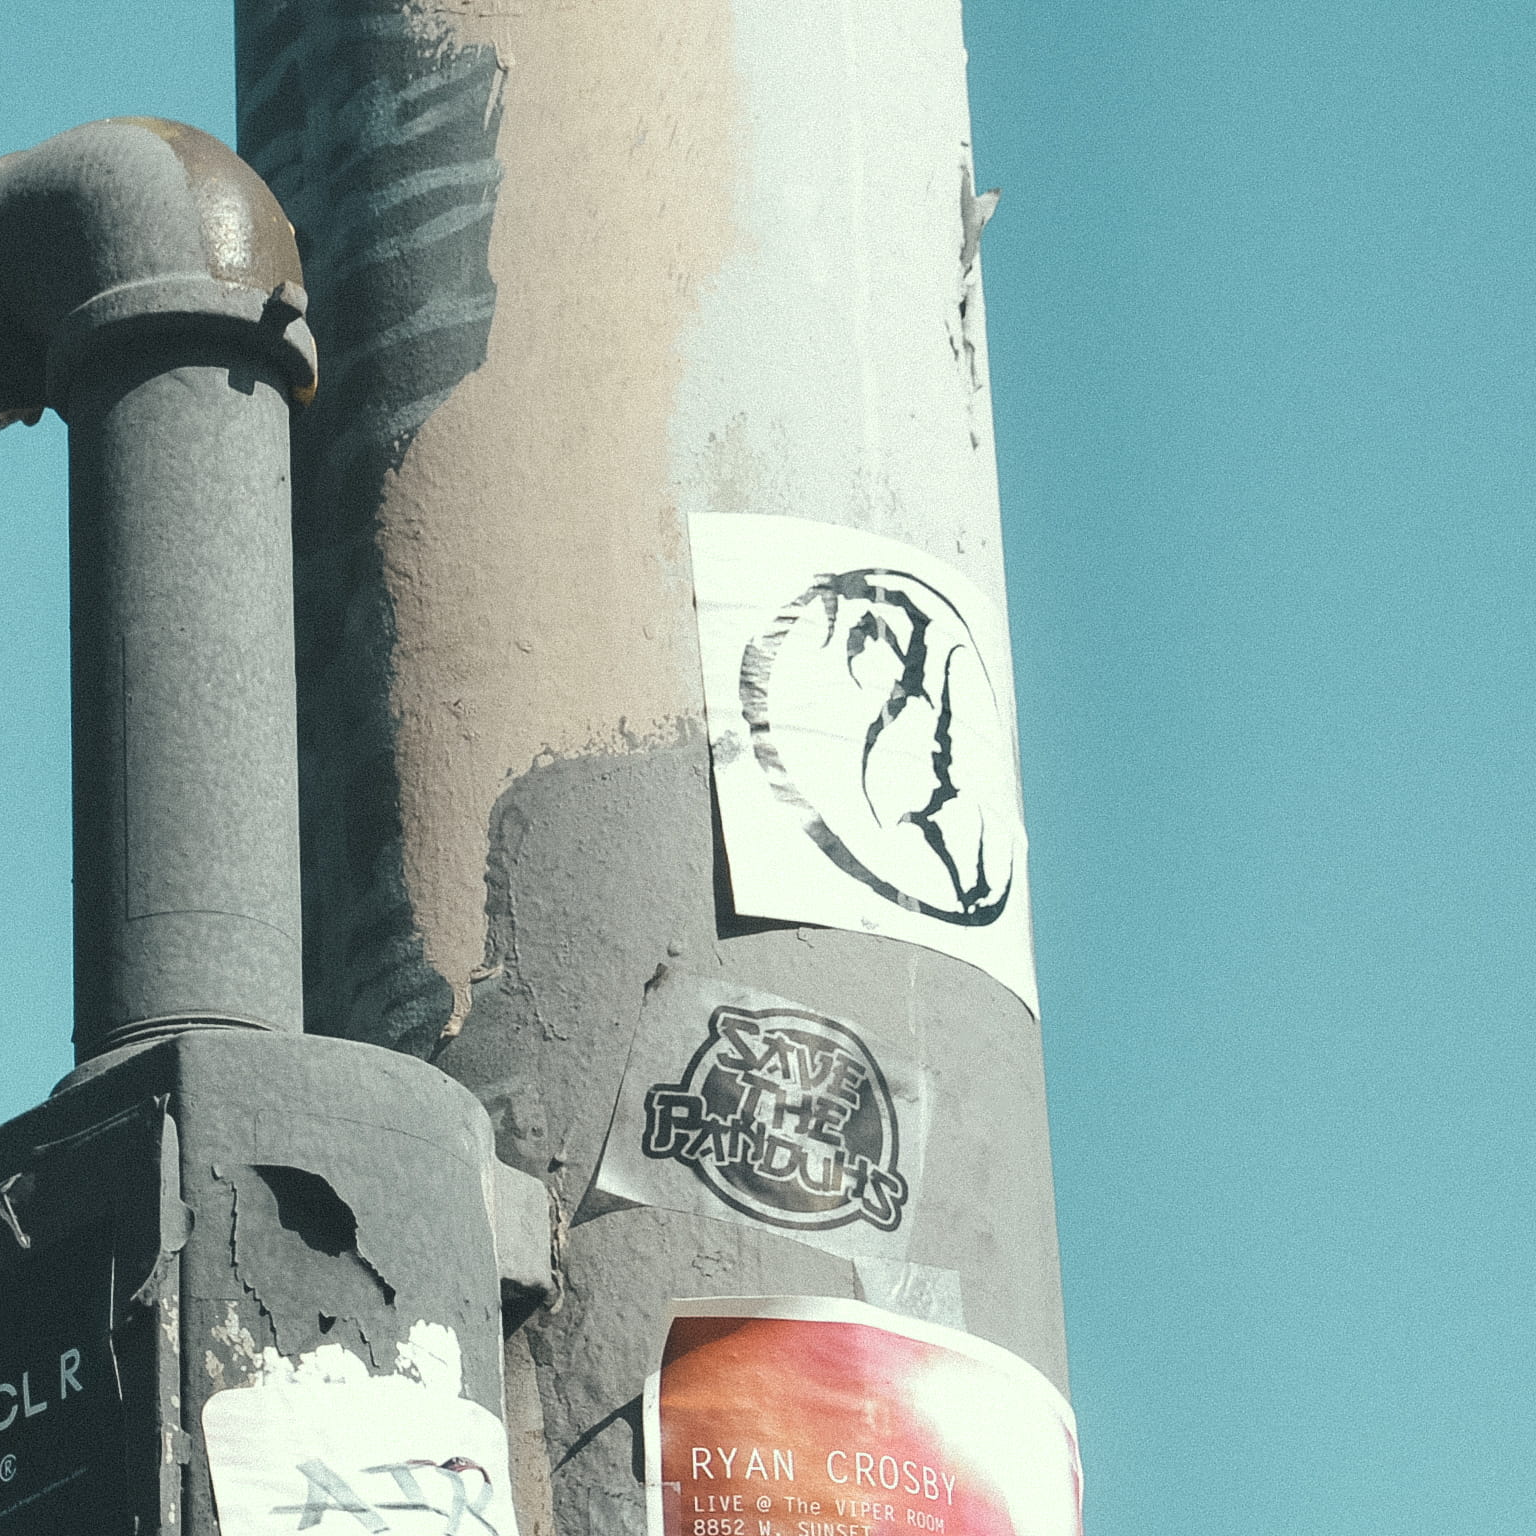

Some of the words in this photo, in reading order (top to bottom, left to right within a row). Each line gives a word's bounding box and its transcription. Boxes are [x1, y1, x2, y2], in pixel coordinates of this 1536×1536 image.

[716, 1015, 867, 1109] SAVE
[736, 1071, 852, 1147] THE
[649, 1091, 904, 1225] PANDUHS
[691, 1447, 795, 1481] RYAN
[826, 1450, 958, 1506] CROSBY
[693, 1495, 744, 1513] LIVE
[756, 1495, 772, 1513] @
[783, 1496, 821, 1515] The
[835, 1500, 896, 1522] VIPER
[906, 1509, 946, 1535] ROOM
[693, 1519, 746, 1536] 8852
